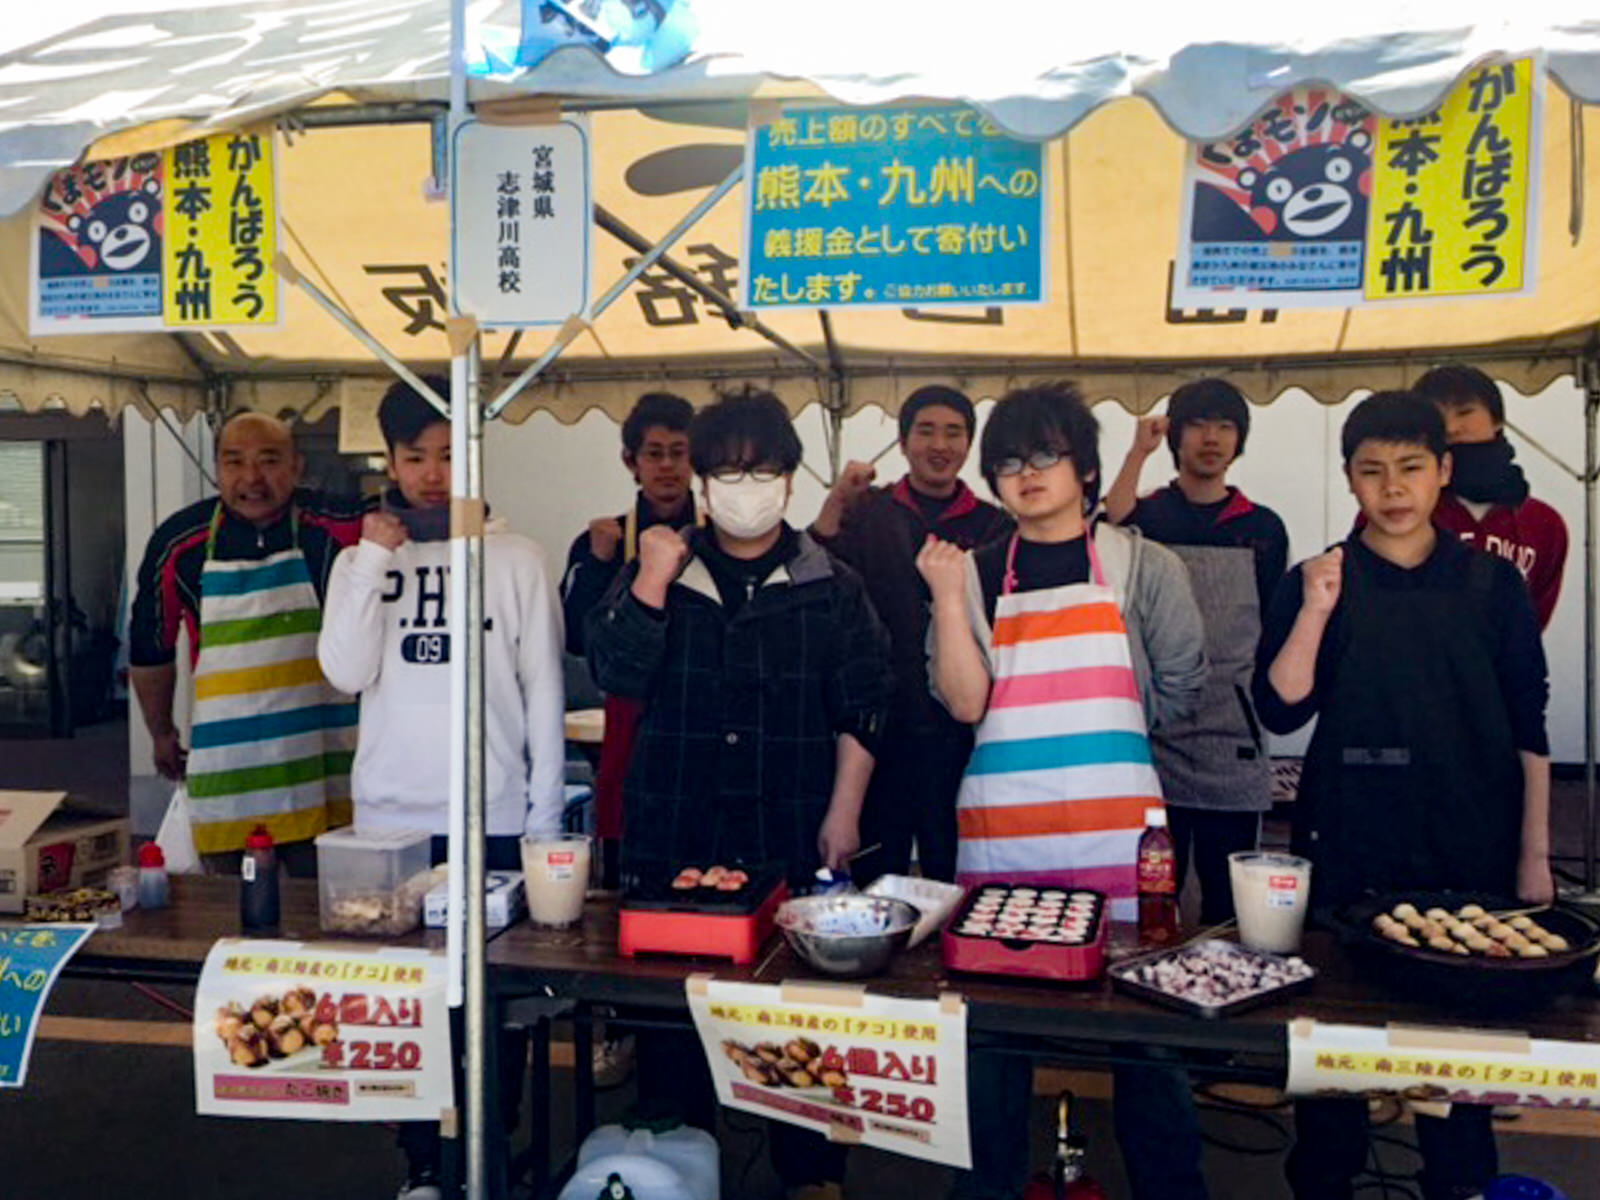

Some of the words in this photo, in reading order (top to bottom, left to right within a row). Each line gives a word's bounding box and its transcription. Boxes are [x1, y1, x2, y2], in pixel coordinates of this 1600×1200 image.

[532, 145, 555, 219] 宮城県
[756, 155, 1039, 211] 熊本・九州への
[1459, 64, 1516, 287] がんばろう
[172, 138, 213, 320] 熊本・九州
[227, 135, 265, 319] がんばろう
[496, 170, 521, 293] 志津川高校
[764, 222, 1030, 259] 義援金として寄付い
[753, 271, 877, 303] たします。
[416, 636, 441, 662] 09
[313, 991, 423, 1028] 6個入り
[822, 1045, 937, 1085] 6個入り
